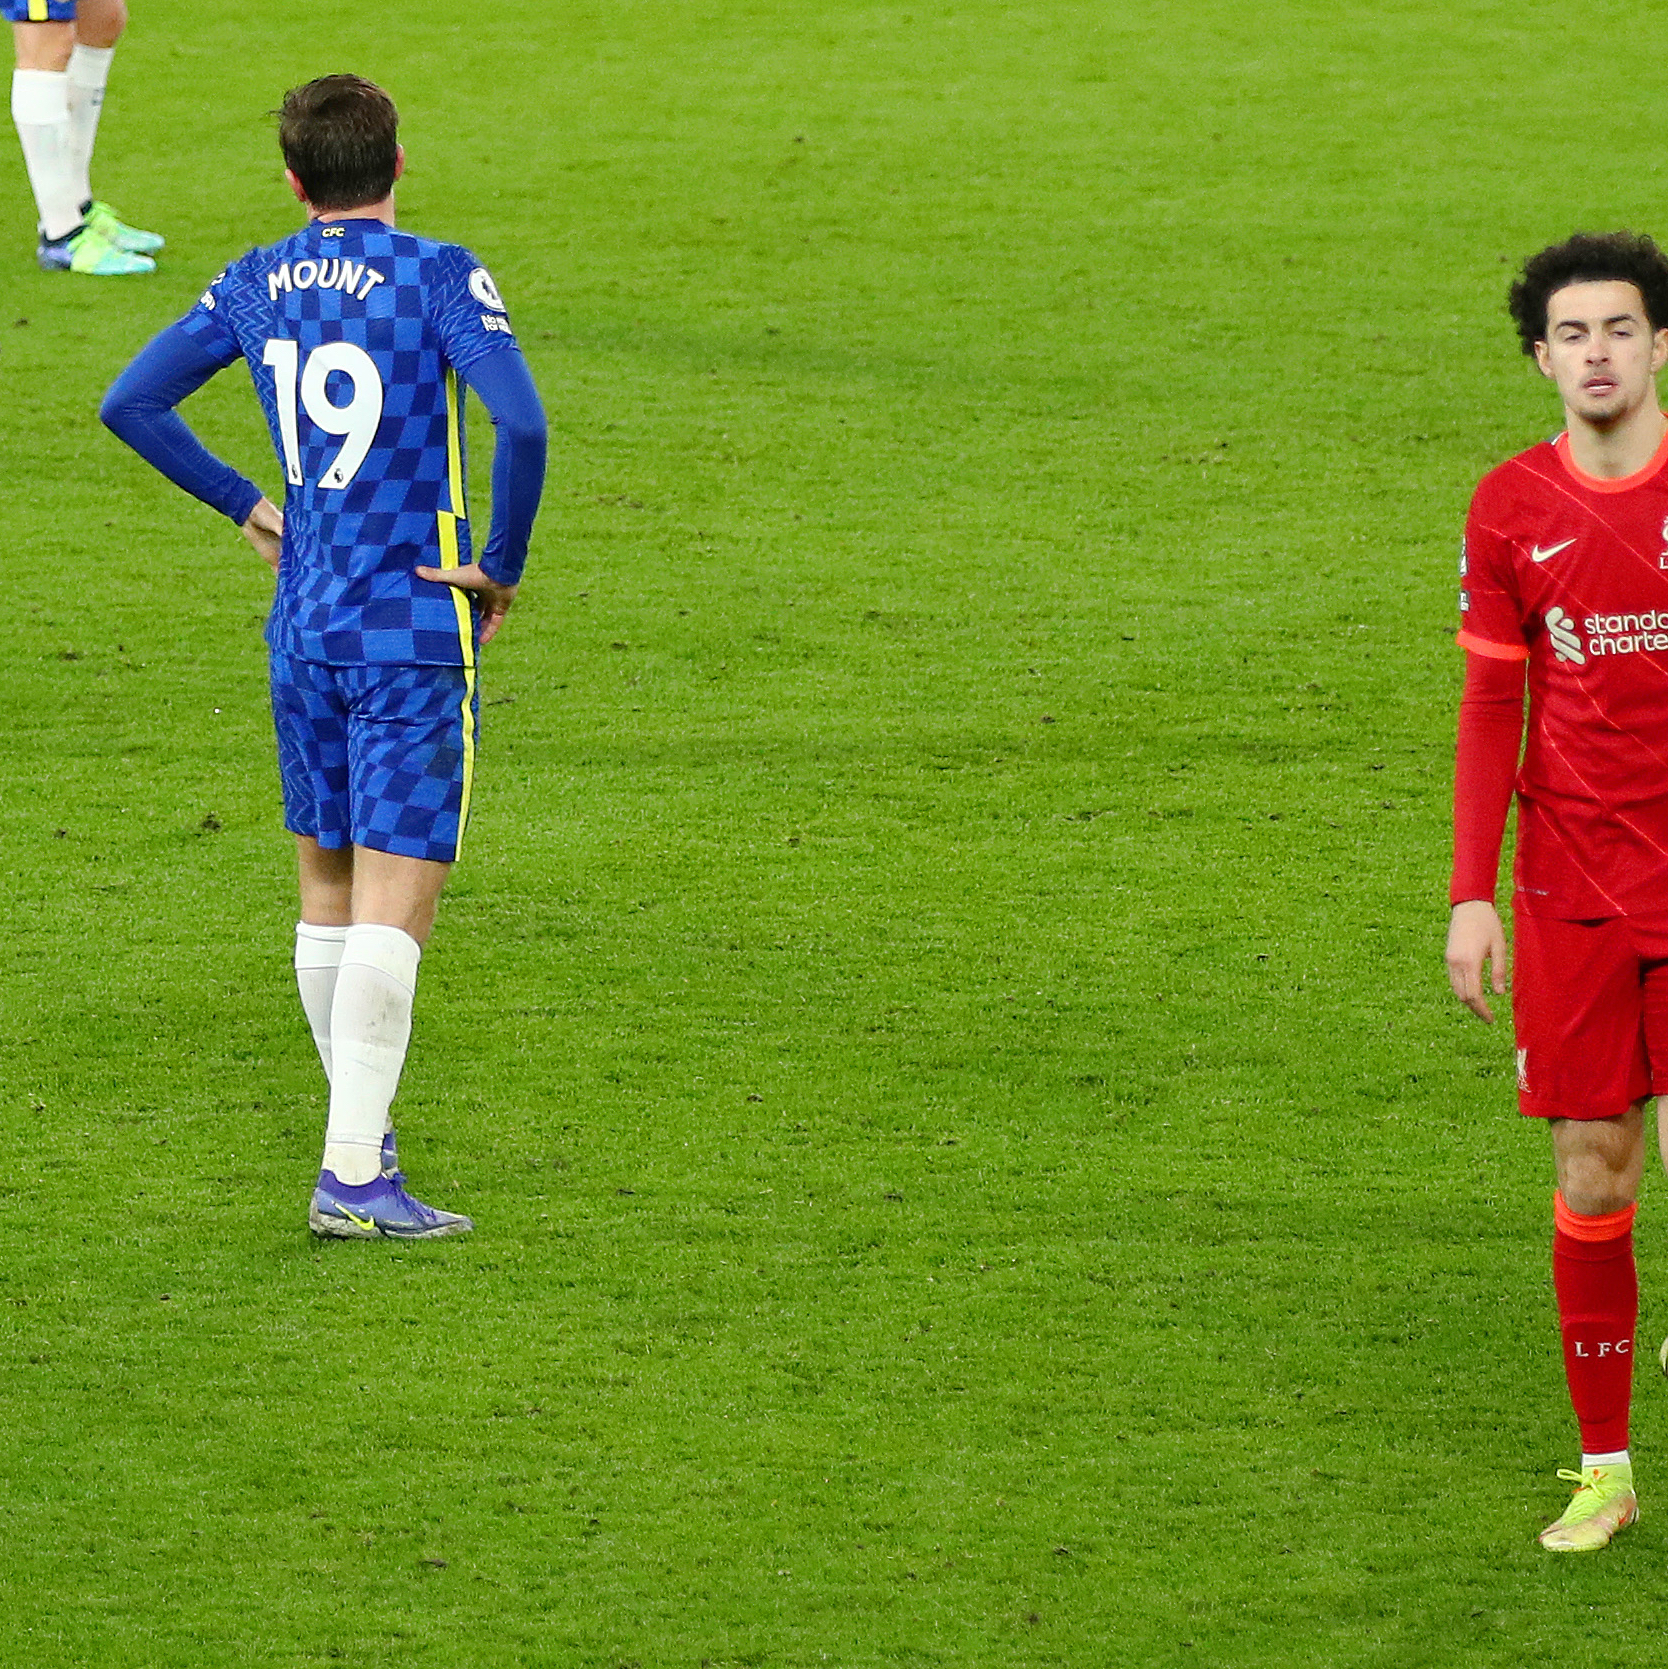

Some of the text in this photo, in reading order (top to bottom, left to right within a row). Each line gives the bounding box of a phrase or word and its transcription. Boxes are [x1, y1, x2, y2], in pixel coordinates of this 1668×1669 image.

[322, 227, 346, 238] CFC
[267, 258, 385, 301] MOUNT
[262, 338, 384, 490] 19
